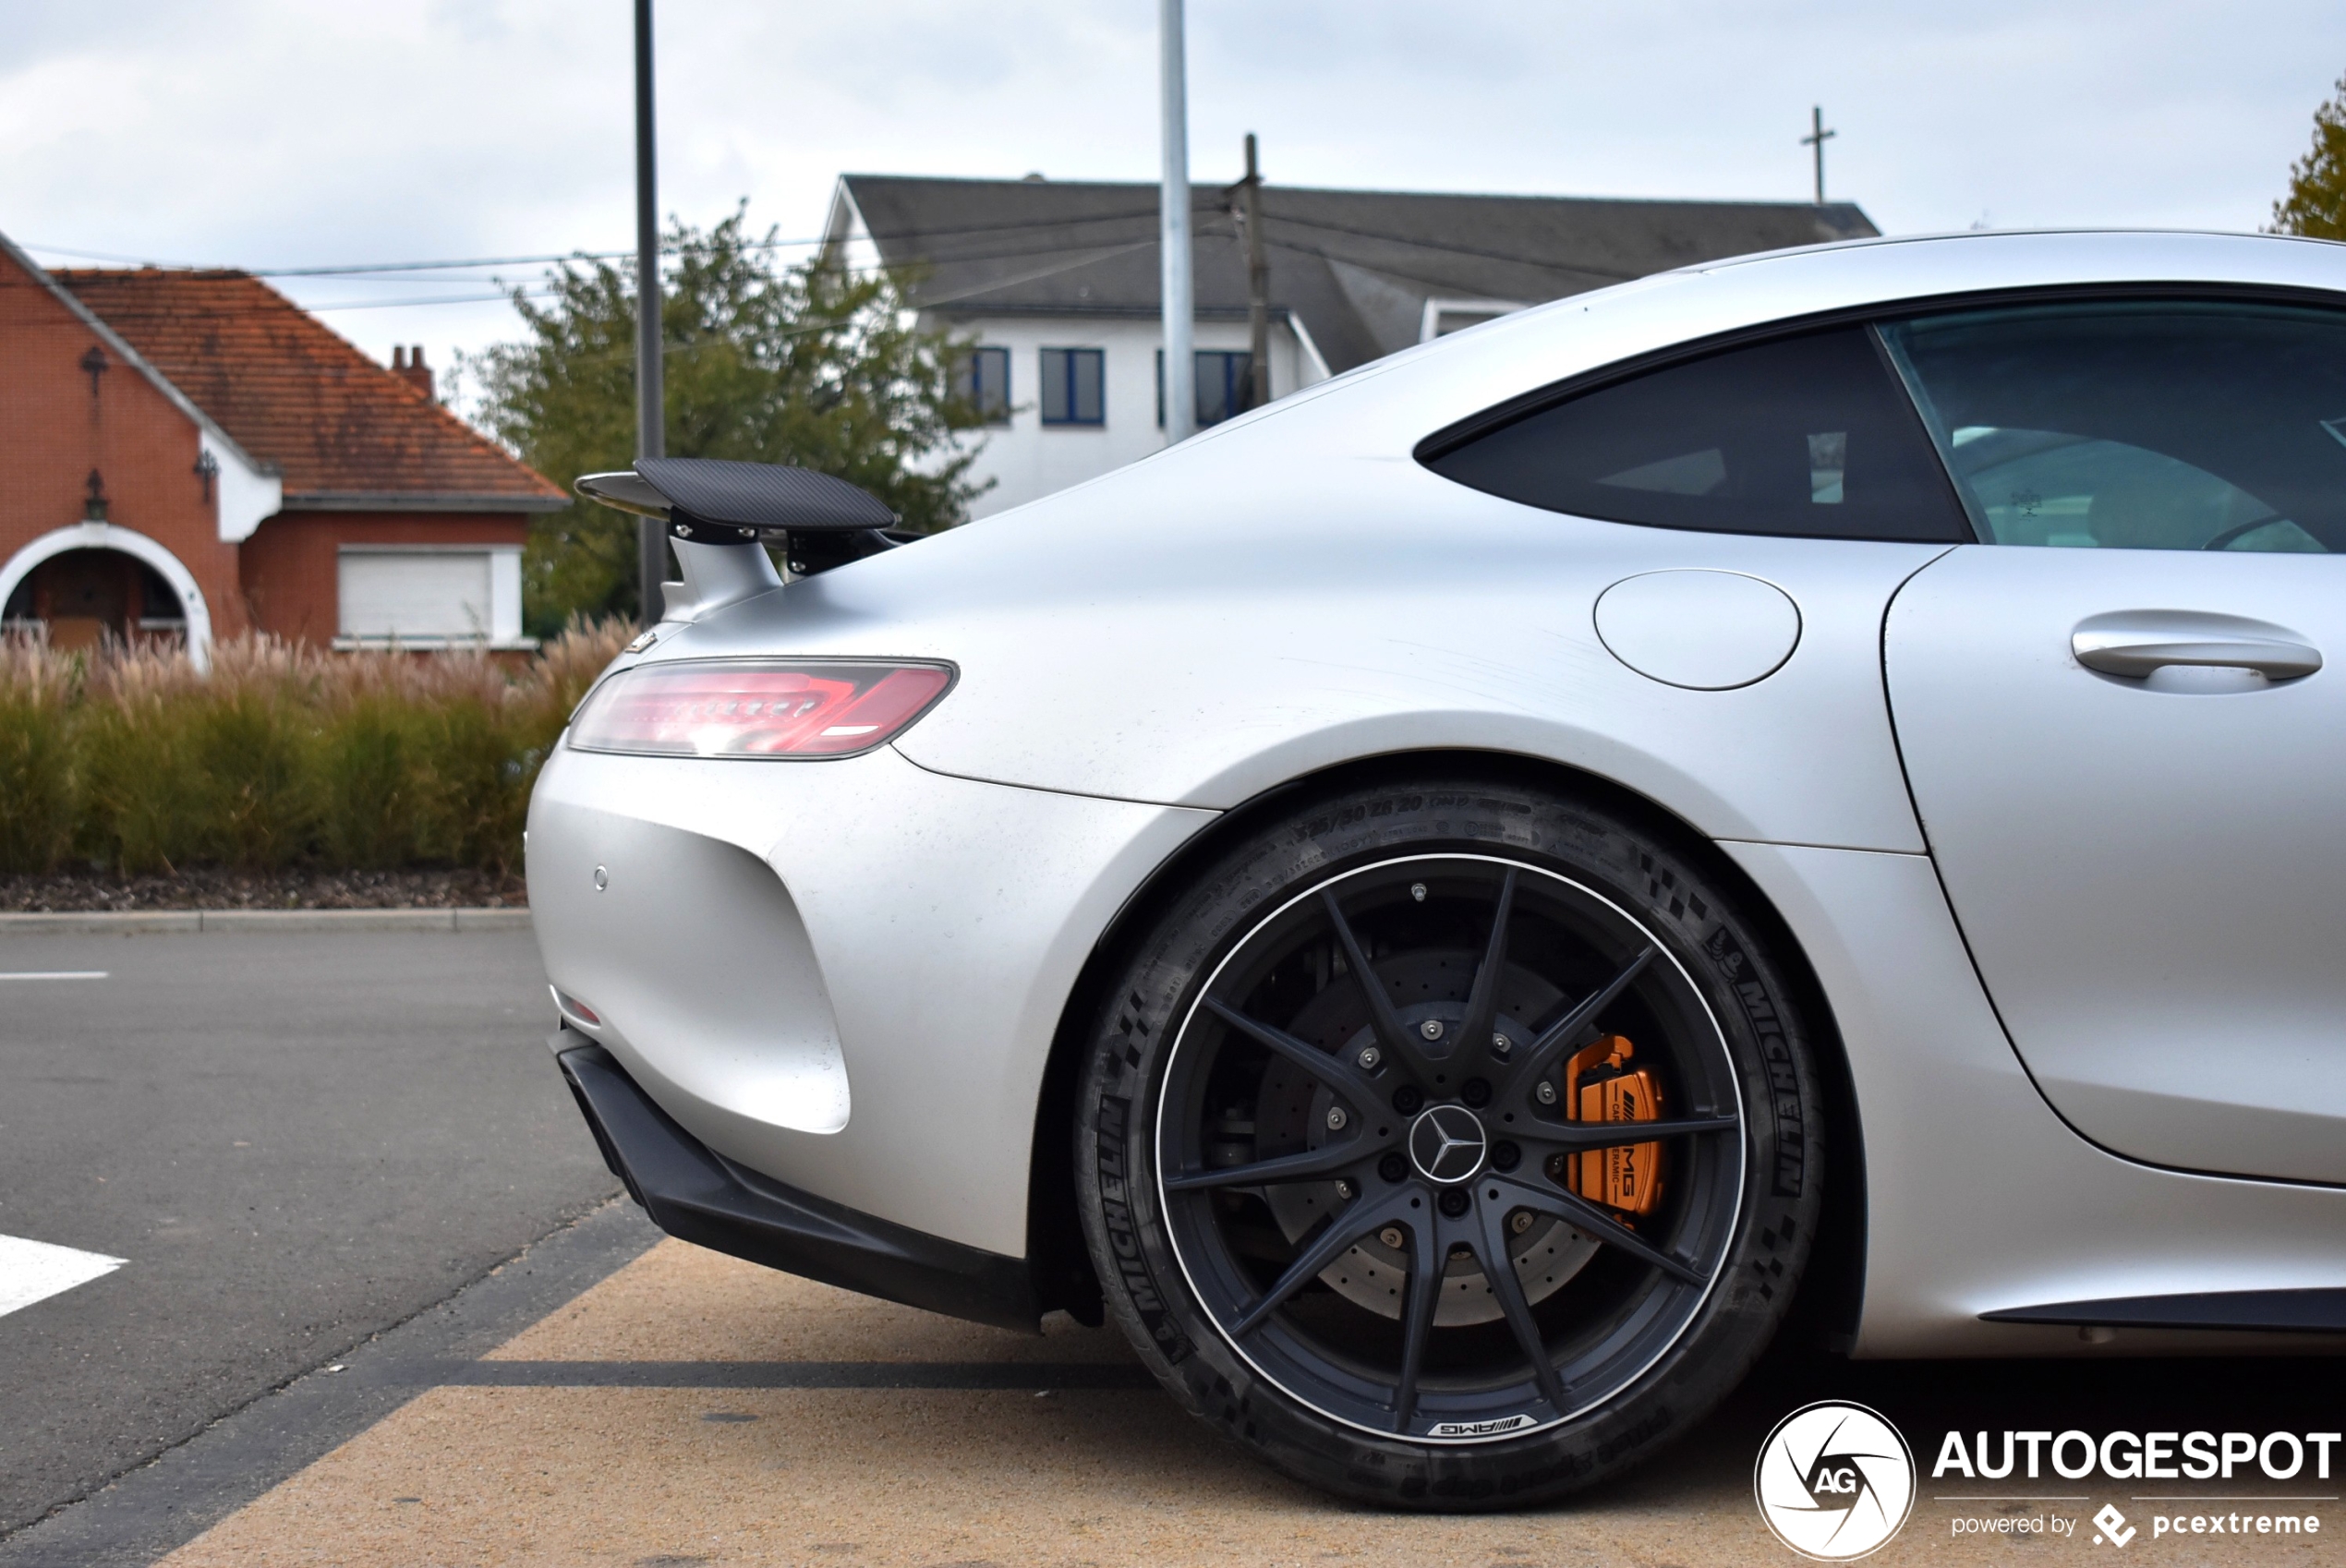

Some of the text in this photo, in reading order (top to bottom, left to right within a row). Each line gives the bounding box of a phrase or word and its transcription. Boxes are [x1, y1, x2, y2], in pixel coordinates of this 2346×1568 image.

[1396, 795, 1422, 812] 20
[1738, 981, 1801, 1194] MICHELIN
[1100, 1098, 1162, 1310] MICHELIN
[1623, 1145, 1634, 1196] MG
